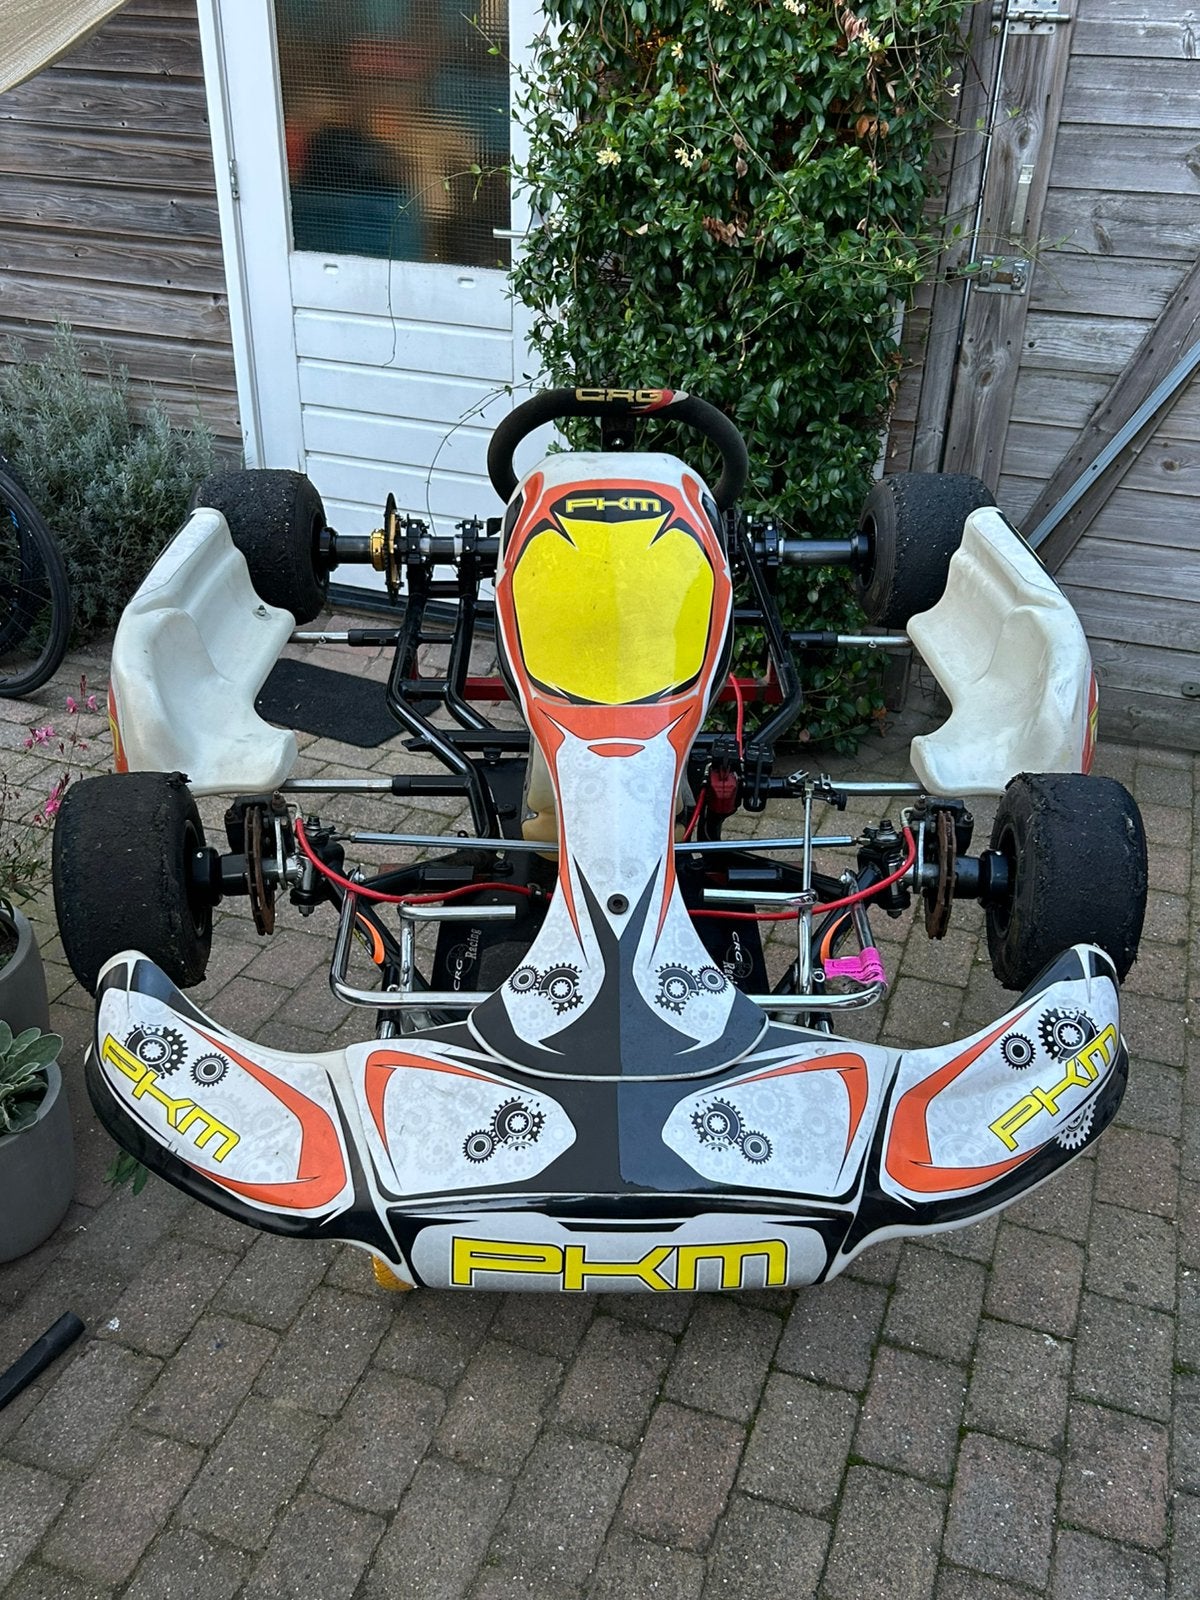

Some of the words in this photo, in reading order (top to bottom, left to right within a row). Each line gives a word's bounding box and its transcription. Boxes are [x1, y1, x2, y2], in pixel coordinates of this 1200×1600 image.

[576, 388, 664, 403] CRG
[464, 928, 482, 960] Racing
[732, 931, 743, 962] CRG
[453, 958, 463, 991] CRG
